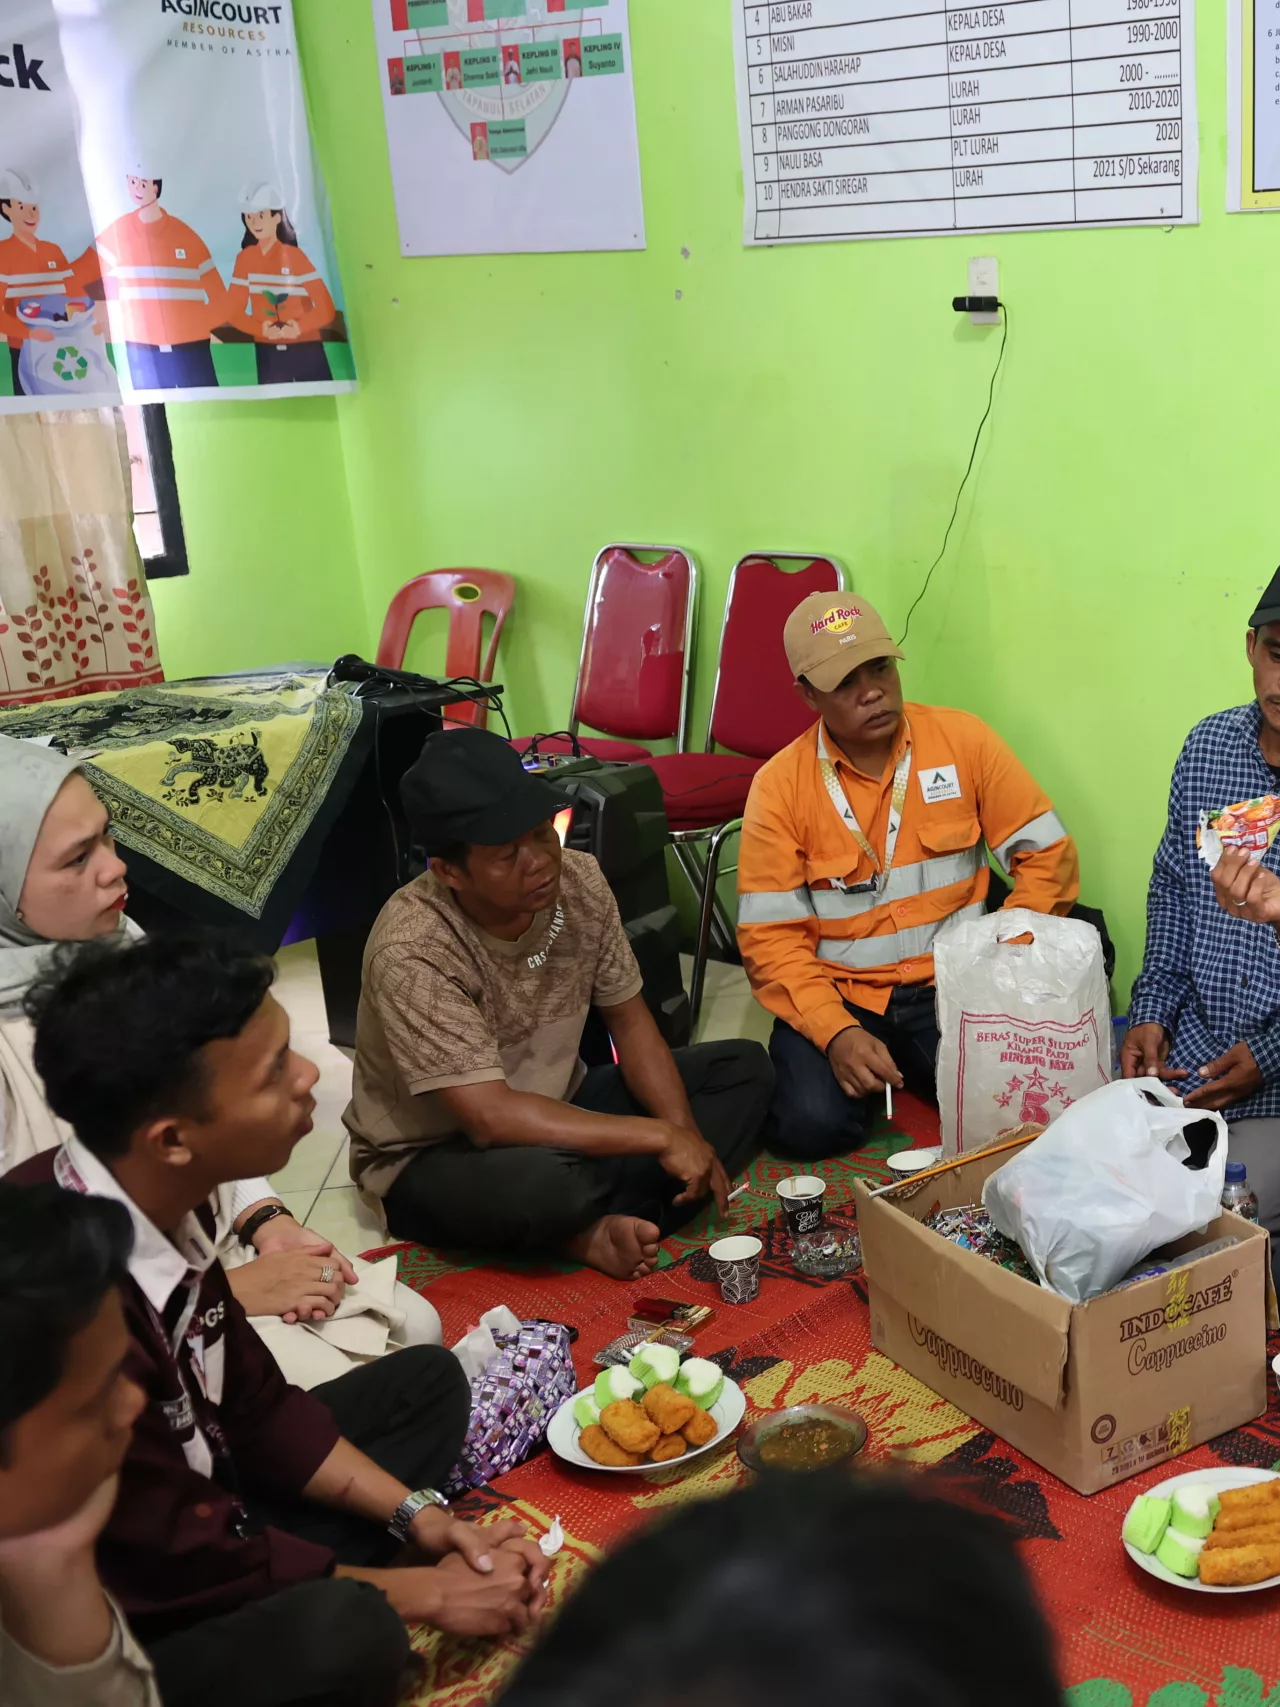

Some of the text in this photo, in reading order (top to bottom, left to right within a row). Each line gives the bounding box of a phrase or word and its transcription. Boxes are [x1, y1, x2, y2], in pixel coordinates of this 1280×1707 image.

[161, 0, 282, 25] AGINCOURT
[755, 2, 812, 26] 4 ABU BAKAR
[183, 22, 266, 41] RESOURCES
[757, 8, 1005, 55] 5 MISNI KEPALA DESA
[1268, 29, 1273, 37] 6
[167, 39, 213, 51] MEMBER
[222, 46, 236, 54] OF
[521, 50, 549, 60] KEPLING
[584, 42, 621, 53] KEPLING IV
[759, 21, 1178, 85] 6 SALAHUDDIN HARAHAP KEPALA DESA 1990-2000
[588, 60, 616, 71] Suyanto
[462, 89, 503, 115] TAPANUL
[761, 63, 1143, 118] 7 ARMAN PASARIBU LURAH 2000
[762, 89, 1179, 144] 8 PANGGONG DONGORAN LURAH 2010-2020
[764, 122, 1179, 172] 9 NAULI BASA PLT LURAH 2020
[764, 155, 1180, 201] 10 HENDRA SAKTI SIREGAR LURAH 2021 S/D Sekarang
[811, 606, 863, 635] Hard Rock
[838, 633, 857, 645] PARIS
[977, 1032, 1011, 1043] BERAS
[1013, 1033, 1046, 1047] SUPER
[1007, 1041, 1070, 1061] KILANG PADI
[1000, 1051, 1046, 1068] BINTANG
[1128, 1323, 1227, 1376] Cappuccino
